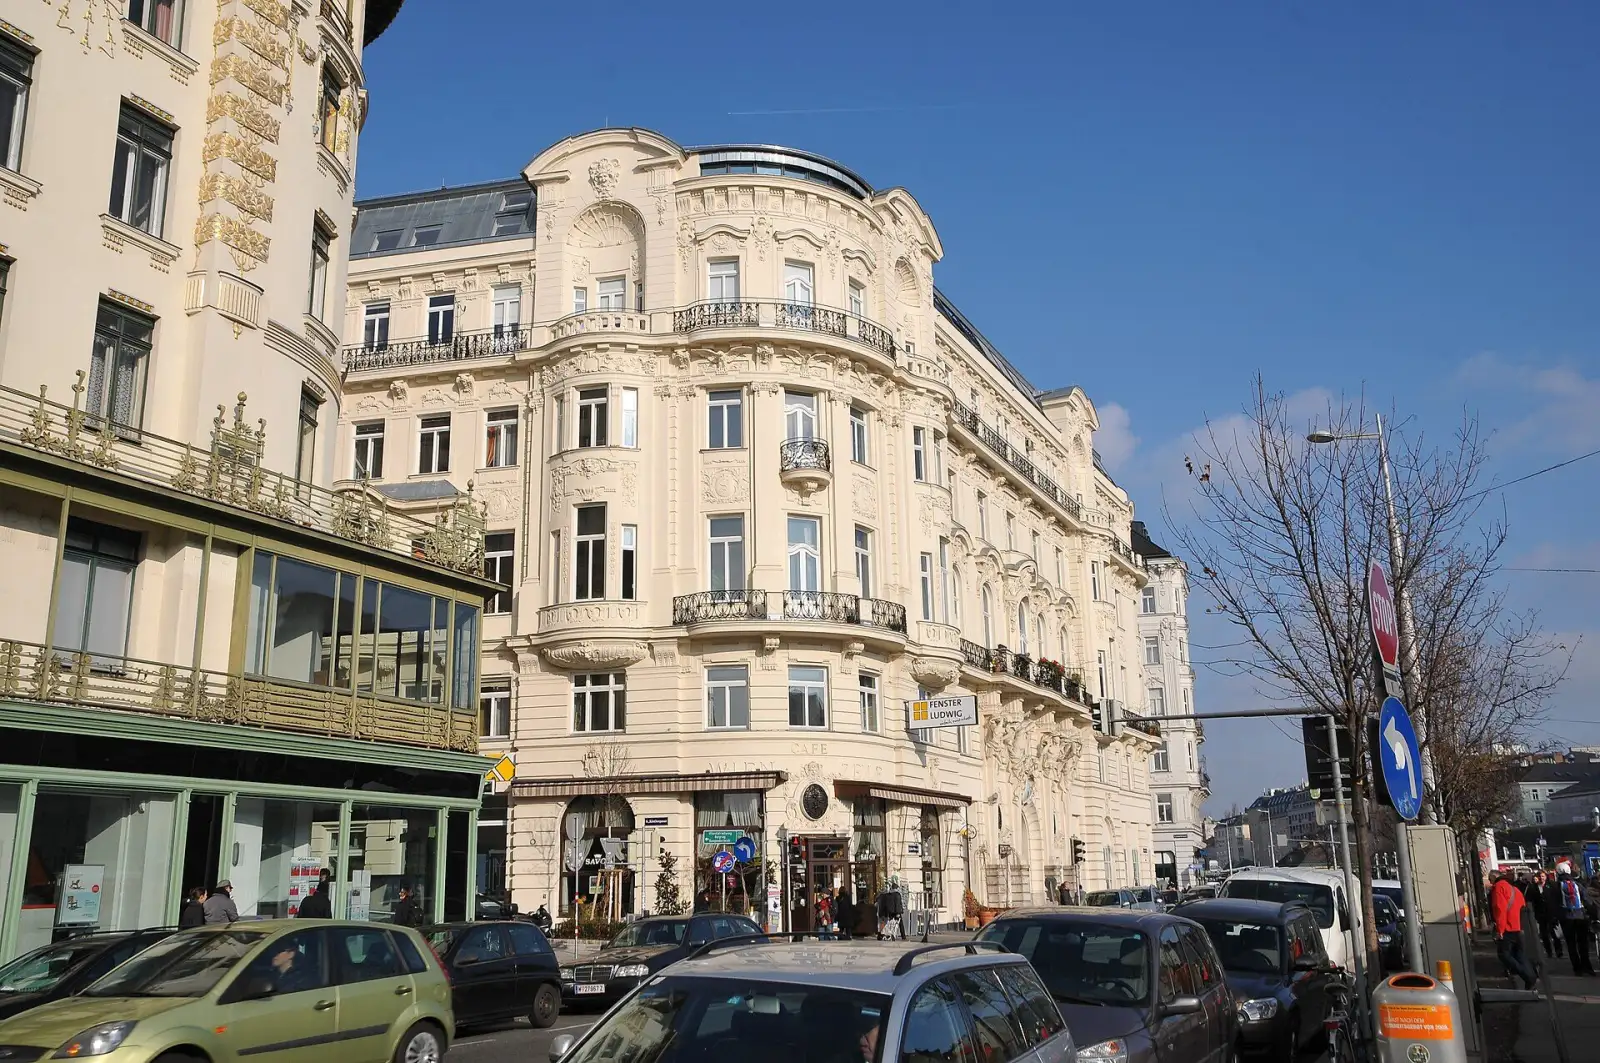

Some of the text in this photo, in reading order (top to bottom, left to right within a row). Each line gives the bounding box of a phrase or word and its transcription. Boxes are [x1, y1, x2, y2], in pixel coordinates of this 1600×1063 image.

[1372, 591, 1392, 636] STOP
[929, 699, 962, 708] FENSTER
[930, 710, 963, 719] LUDWIG
[791, 743, 828, 755] CAFE
[585, 857, 608, 865] SAVO
